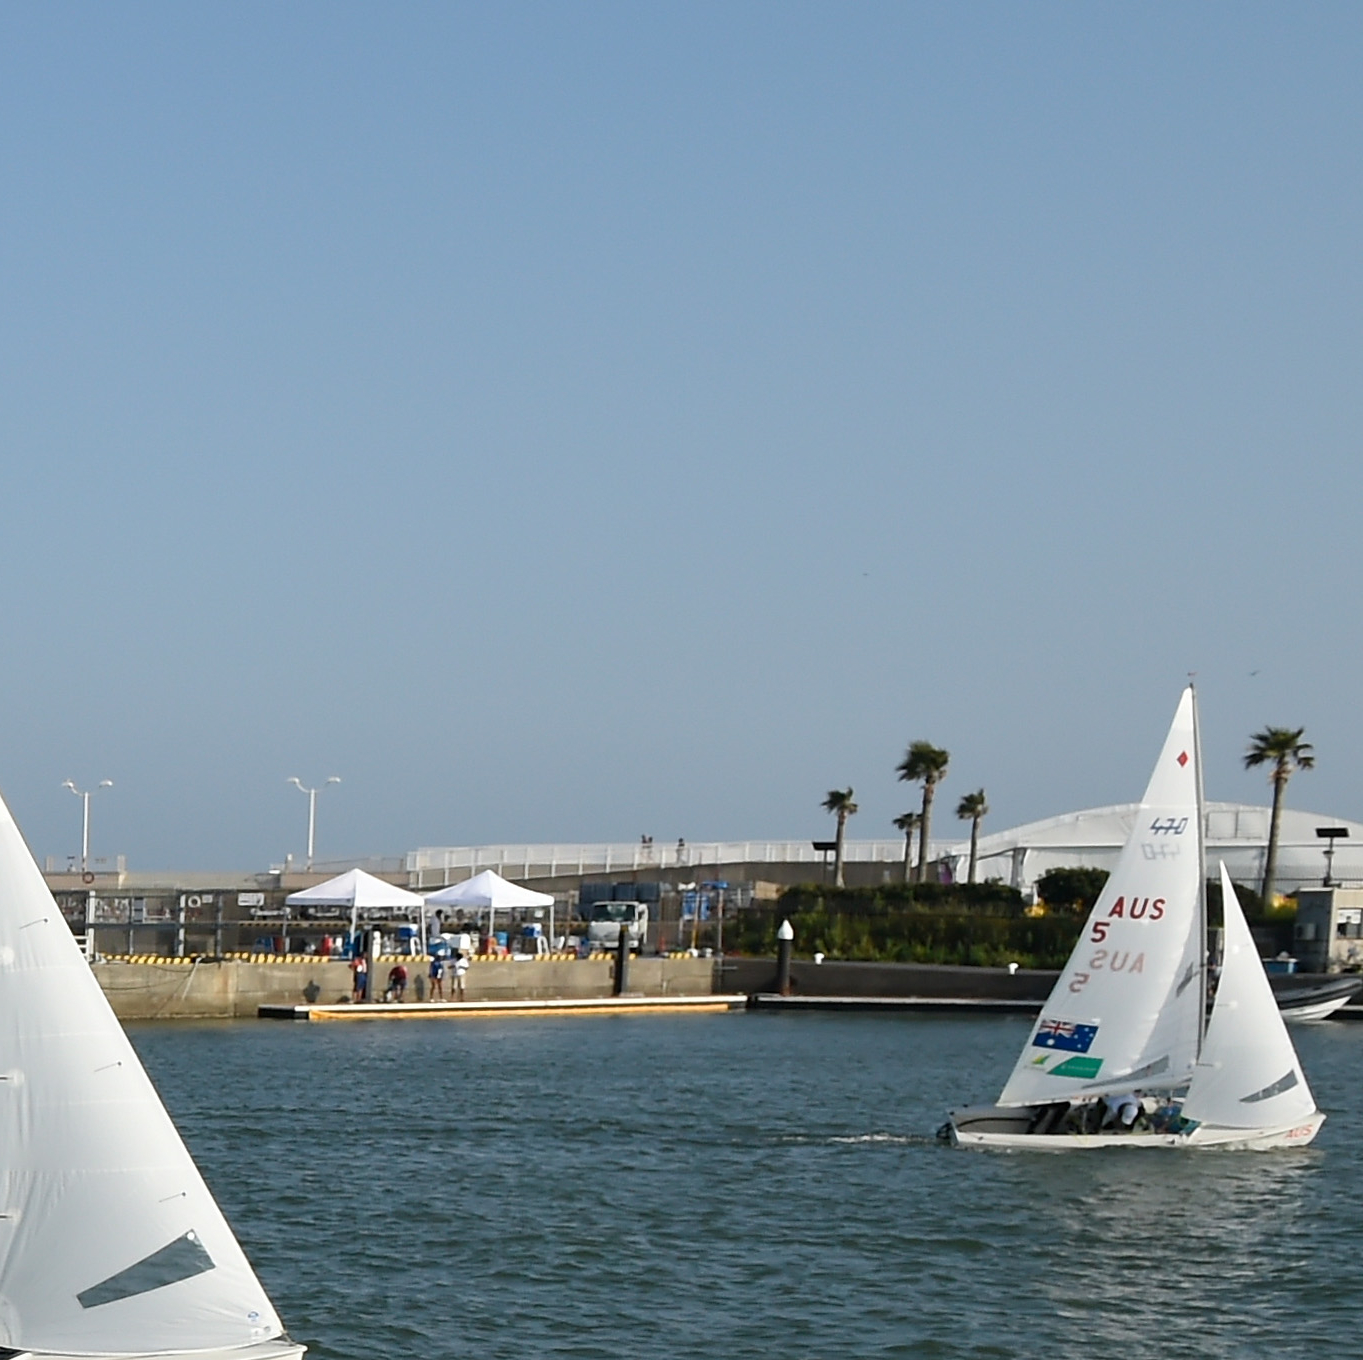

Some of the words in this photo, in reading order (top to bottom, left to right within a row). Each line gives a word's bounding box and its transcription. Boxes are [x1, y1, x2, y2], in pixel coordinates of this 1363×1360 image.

[1150, 817, 1188, 835] 470
[1108, 896, 1166, 920] AUS
[1090, 921, 1110, 943] 5
